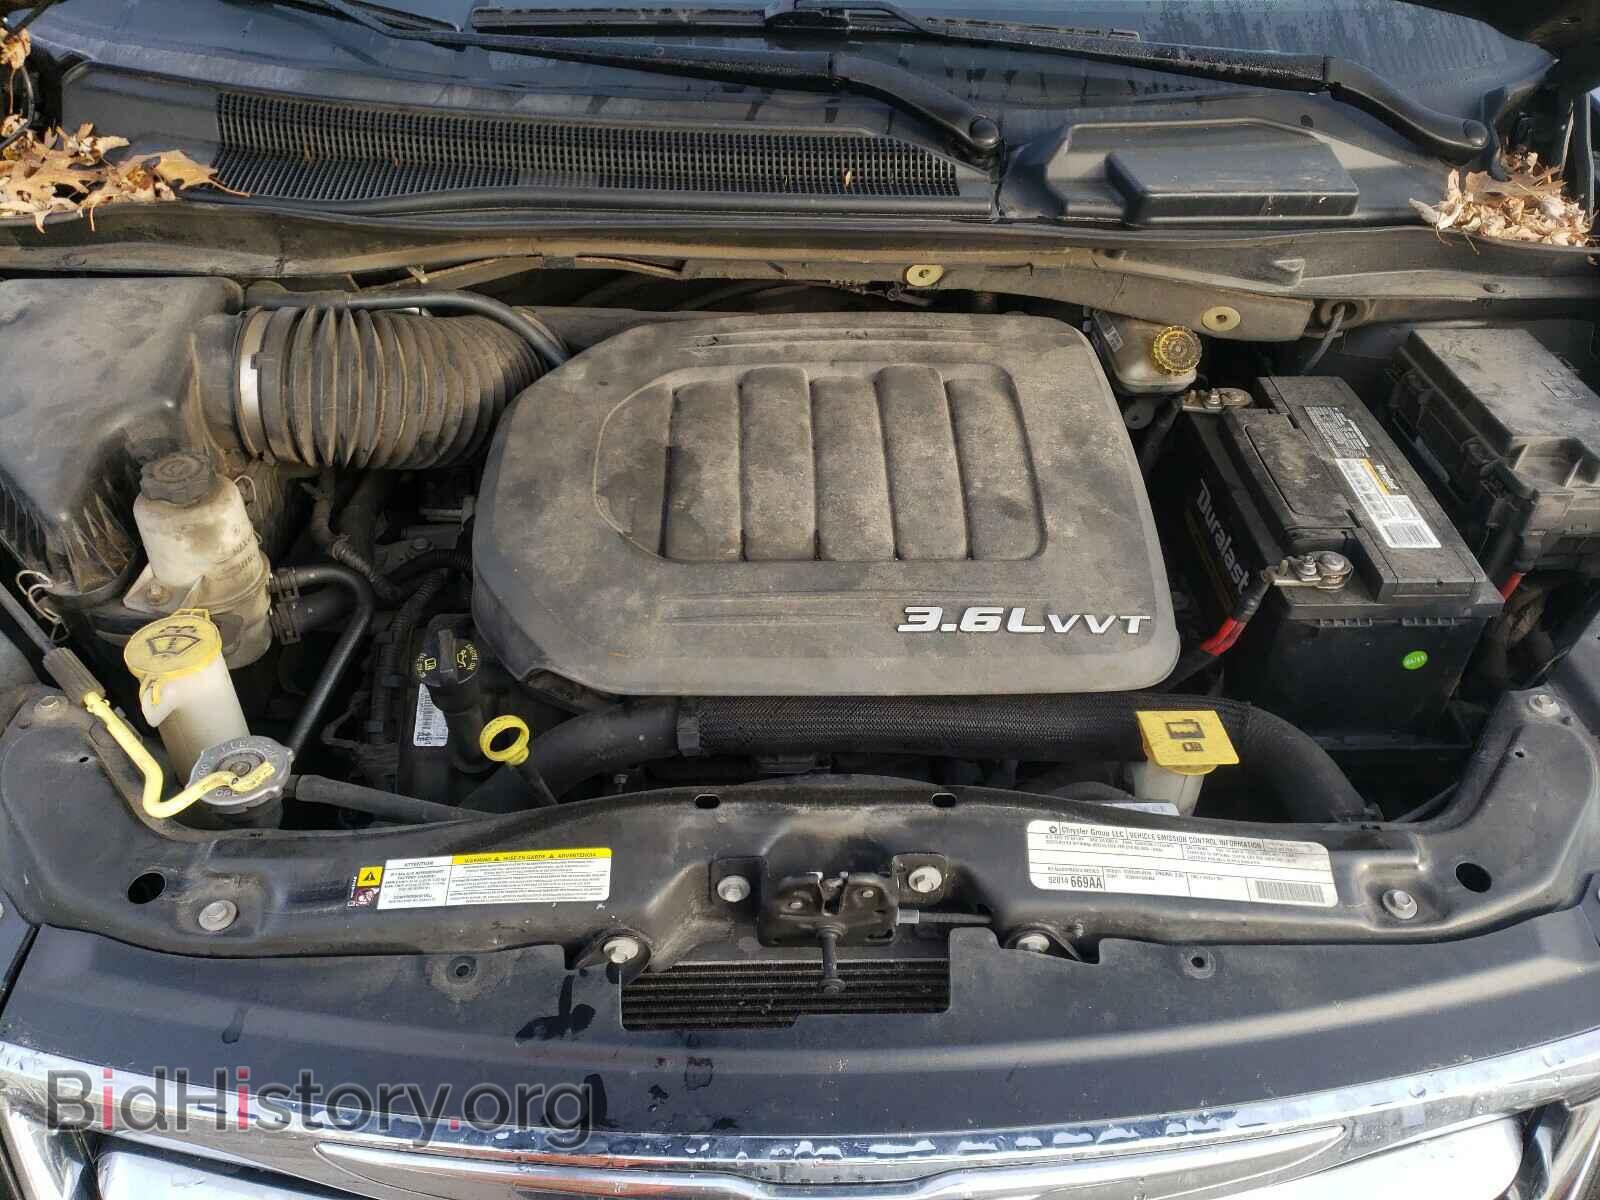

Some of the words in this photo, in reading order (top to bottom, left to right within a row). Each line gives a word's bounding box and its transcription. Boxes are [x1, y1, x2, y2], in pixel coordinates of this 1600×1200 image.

[1197, 478, 1249, 595] Duralast
[897, 606, 1046, 633] 3.6L
[1047, 614, 1151, 634] VVT
[1061, 825, 1088, 836] Chrysler
[1090, 828, 1110, 838] Group
[1112, 830, 1125, 838] LLC
[1129, 831, 1155, 841] VEHICLE
[1157, 833, 1187, 843] EMISSION
[1188, 836, 1217, 845] CONTROL
[1219, 839, 1261, 849] INFORMATION
[1070, 875, 1103, 889] 669AA
